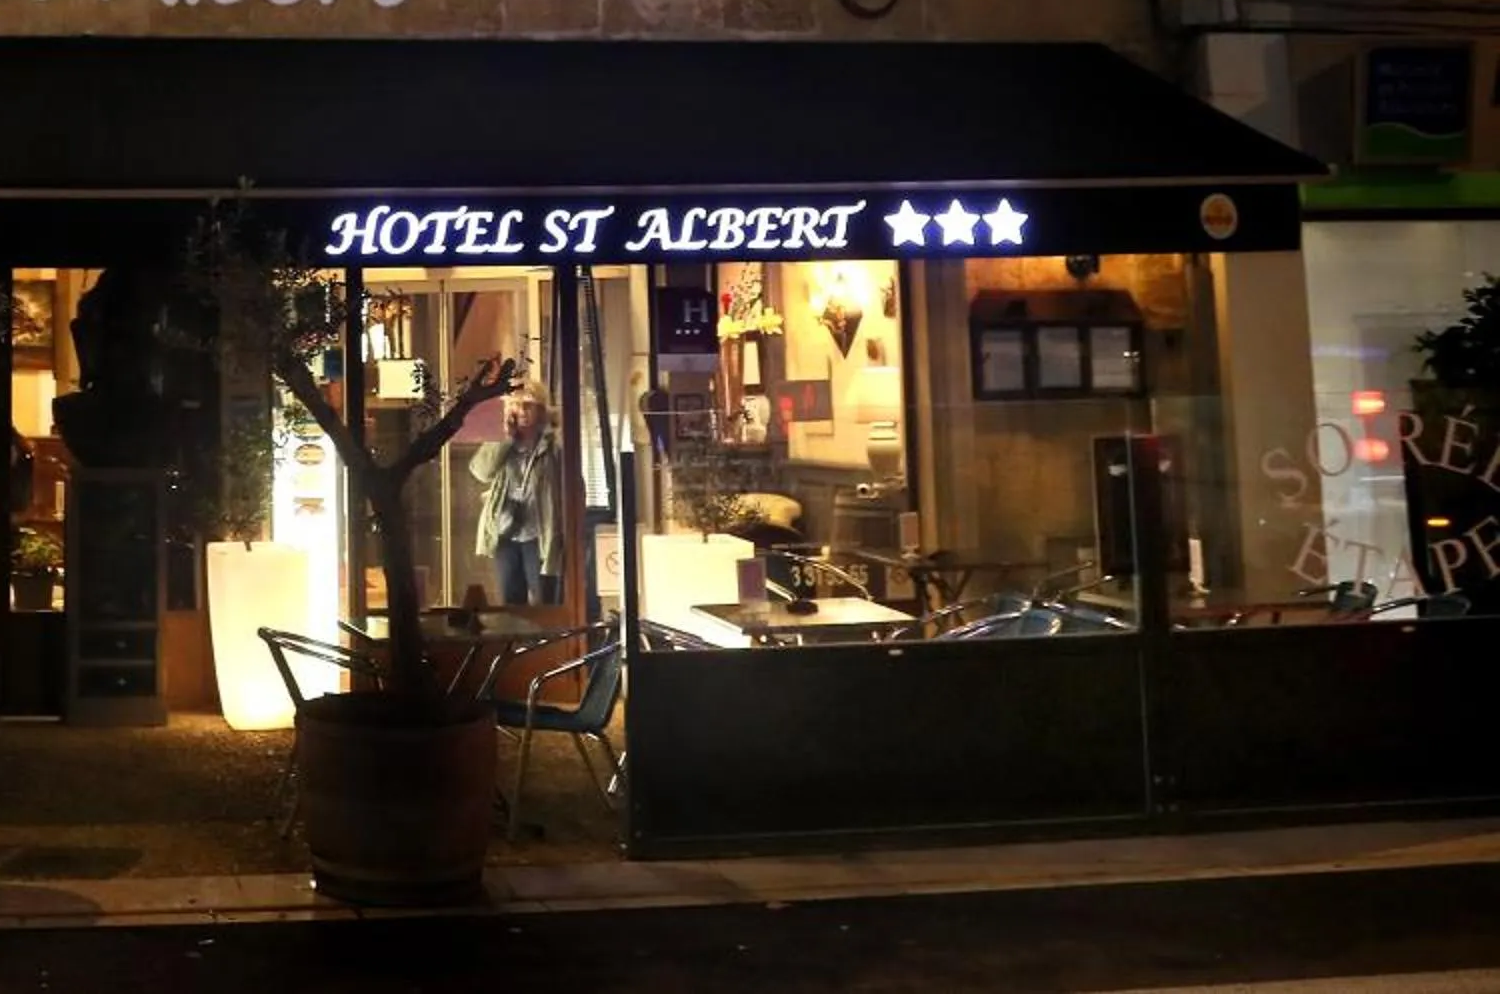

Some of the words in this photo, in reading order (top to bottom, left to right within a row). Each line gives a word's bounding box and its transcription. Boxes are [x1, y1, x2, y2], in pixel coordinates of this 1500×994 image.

[324, 205, 524, 255] HOTEL
[538, 205, 615, 253] ST
[624, 199, 868, 251] ALBERT
